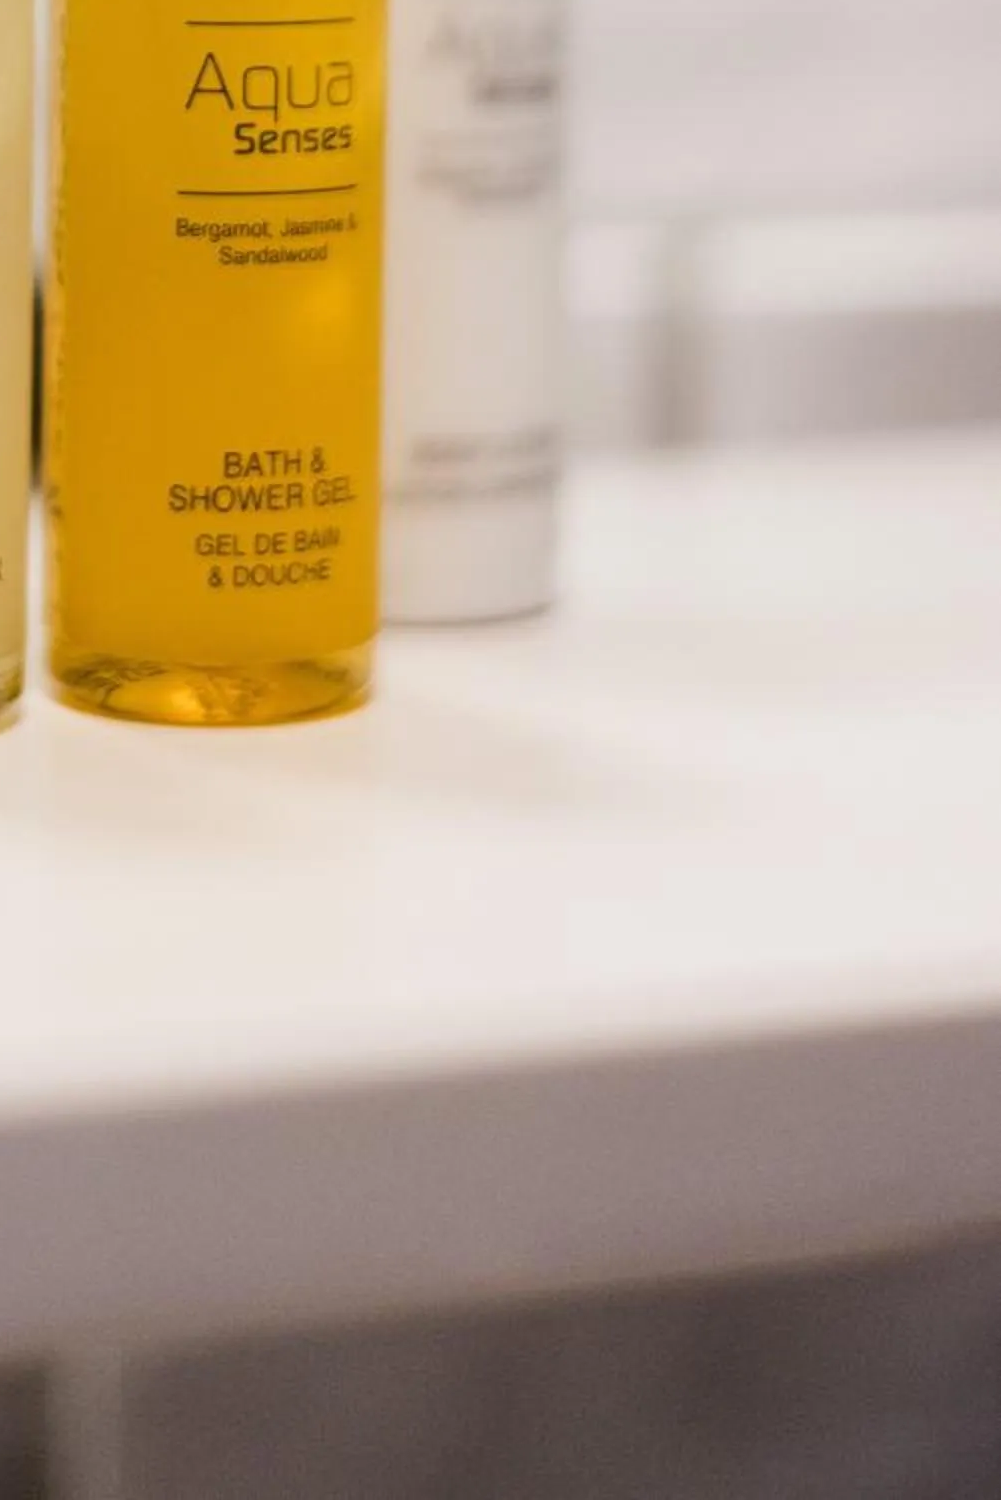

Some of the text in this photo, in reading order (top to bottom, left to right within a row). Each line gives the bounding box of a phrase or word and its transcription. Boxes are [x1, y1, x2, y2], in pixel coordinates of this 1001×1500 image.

[184, 51, 354, 123] Aqua
[232, 121, 353, 156] Senses
[175, 217, 274, 244] Bergamot,
[218, 242, 329, 267] Sandalwood
[222, 445, 327, 480] BATH &
[167, 481, 304, 515] SHOWER
[311, 475, 358, 508] GEL
[194, 525, 342, 558] GEL DE BAIN
[206, 557, 333, 590] & DOUCHE
